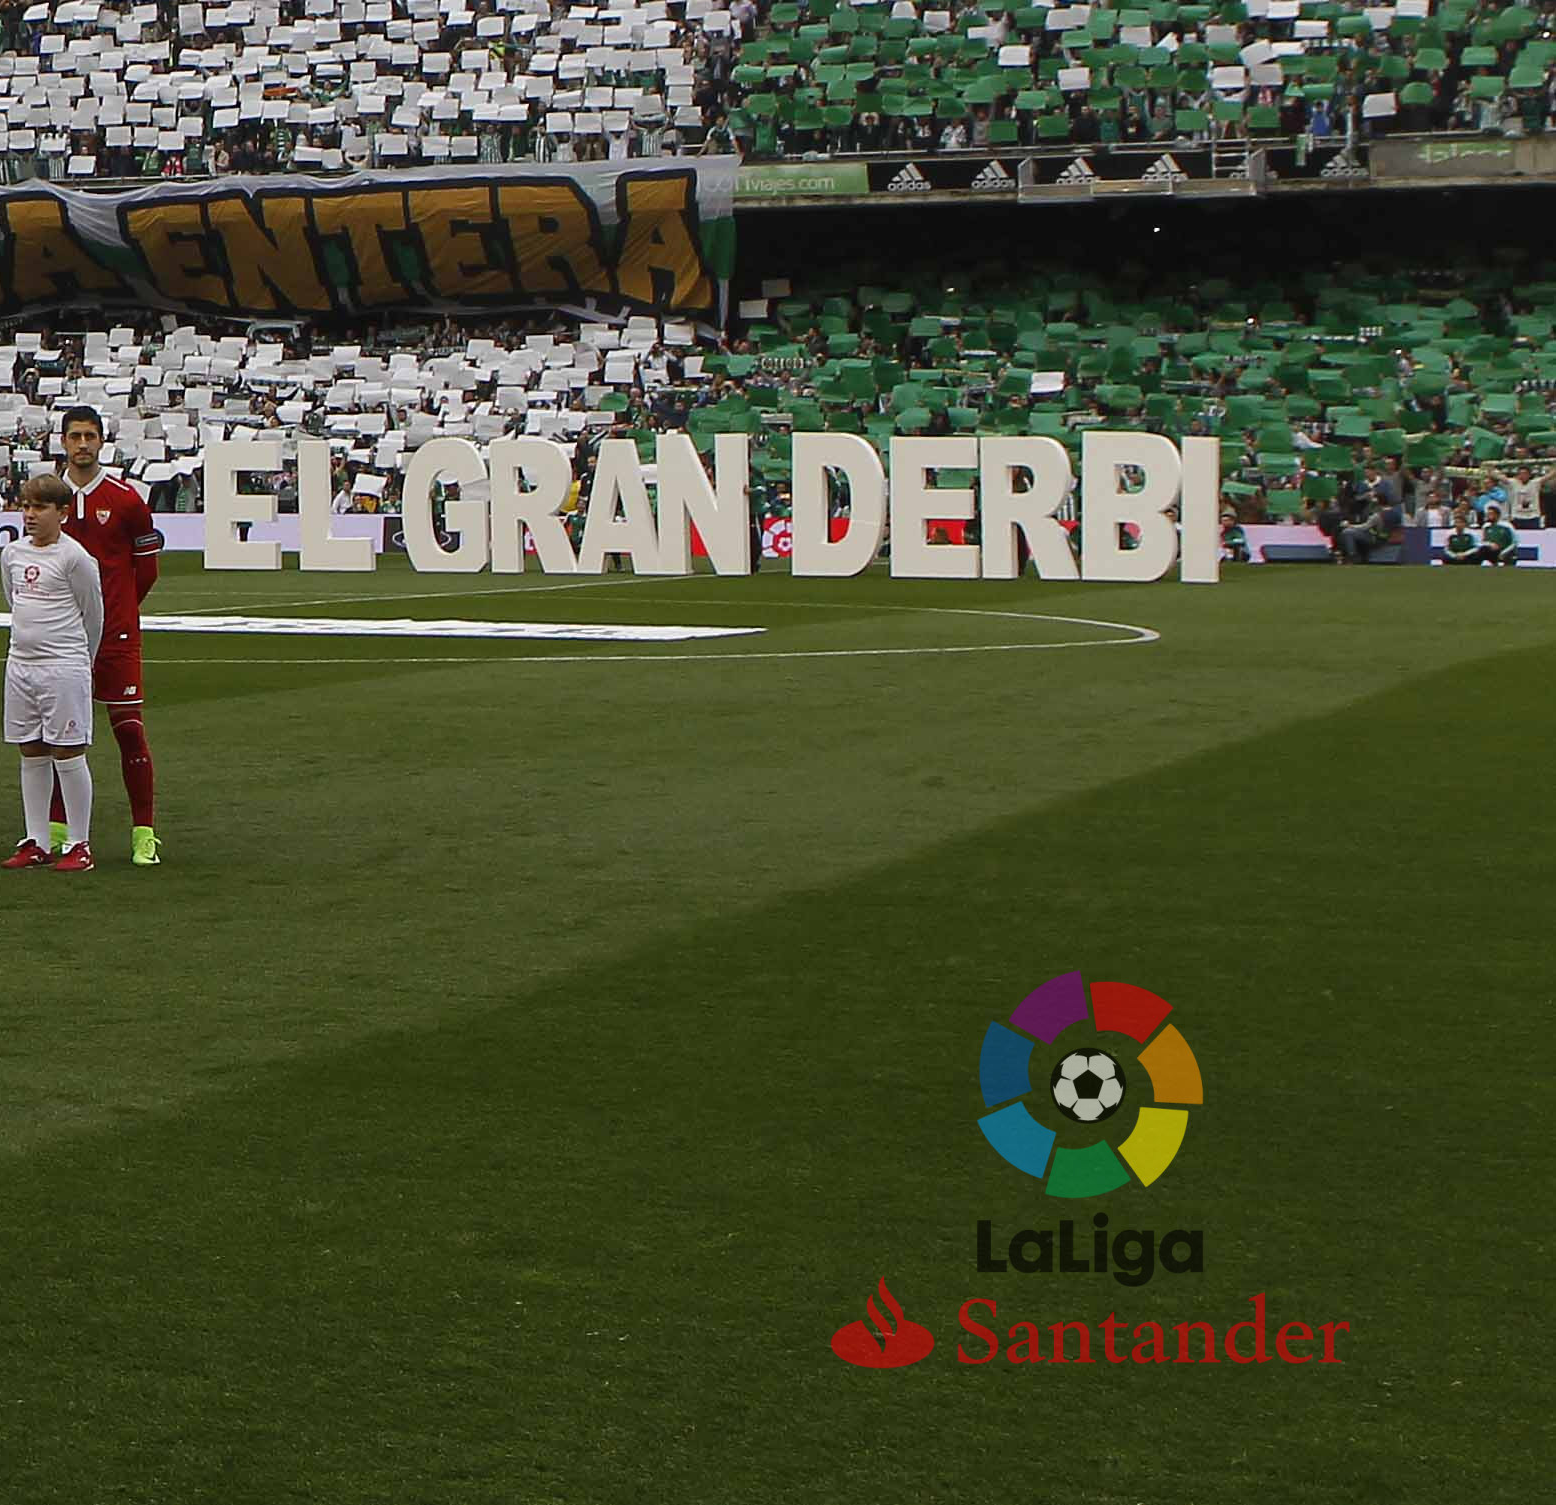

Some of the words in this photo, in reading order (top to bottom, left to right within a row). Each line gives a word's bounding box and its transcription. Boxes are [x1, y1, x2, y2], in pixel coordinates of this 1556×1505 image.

[887, 180, 931, 192] adidas
[971, 177, 1016, 189] adidas
[121, 172, 718, 312] ENTERA
[203, 440, 376, 572] EL
[402, 433, 752, 575] GRAN
[791, 431, 1220, 583] DERBI
